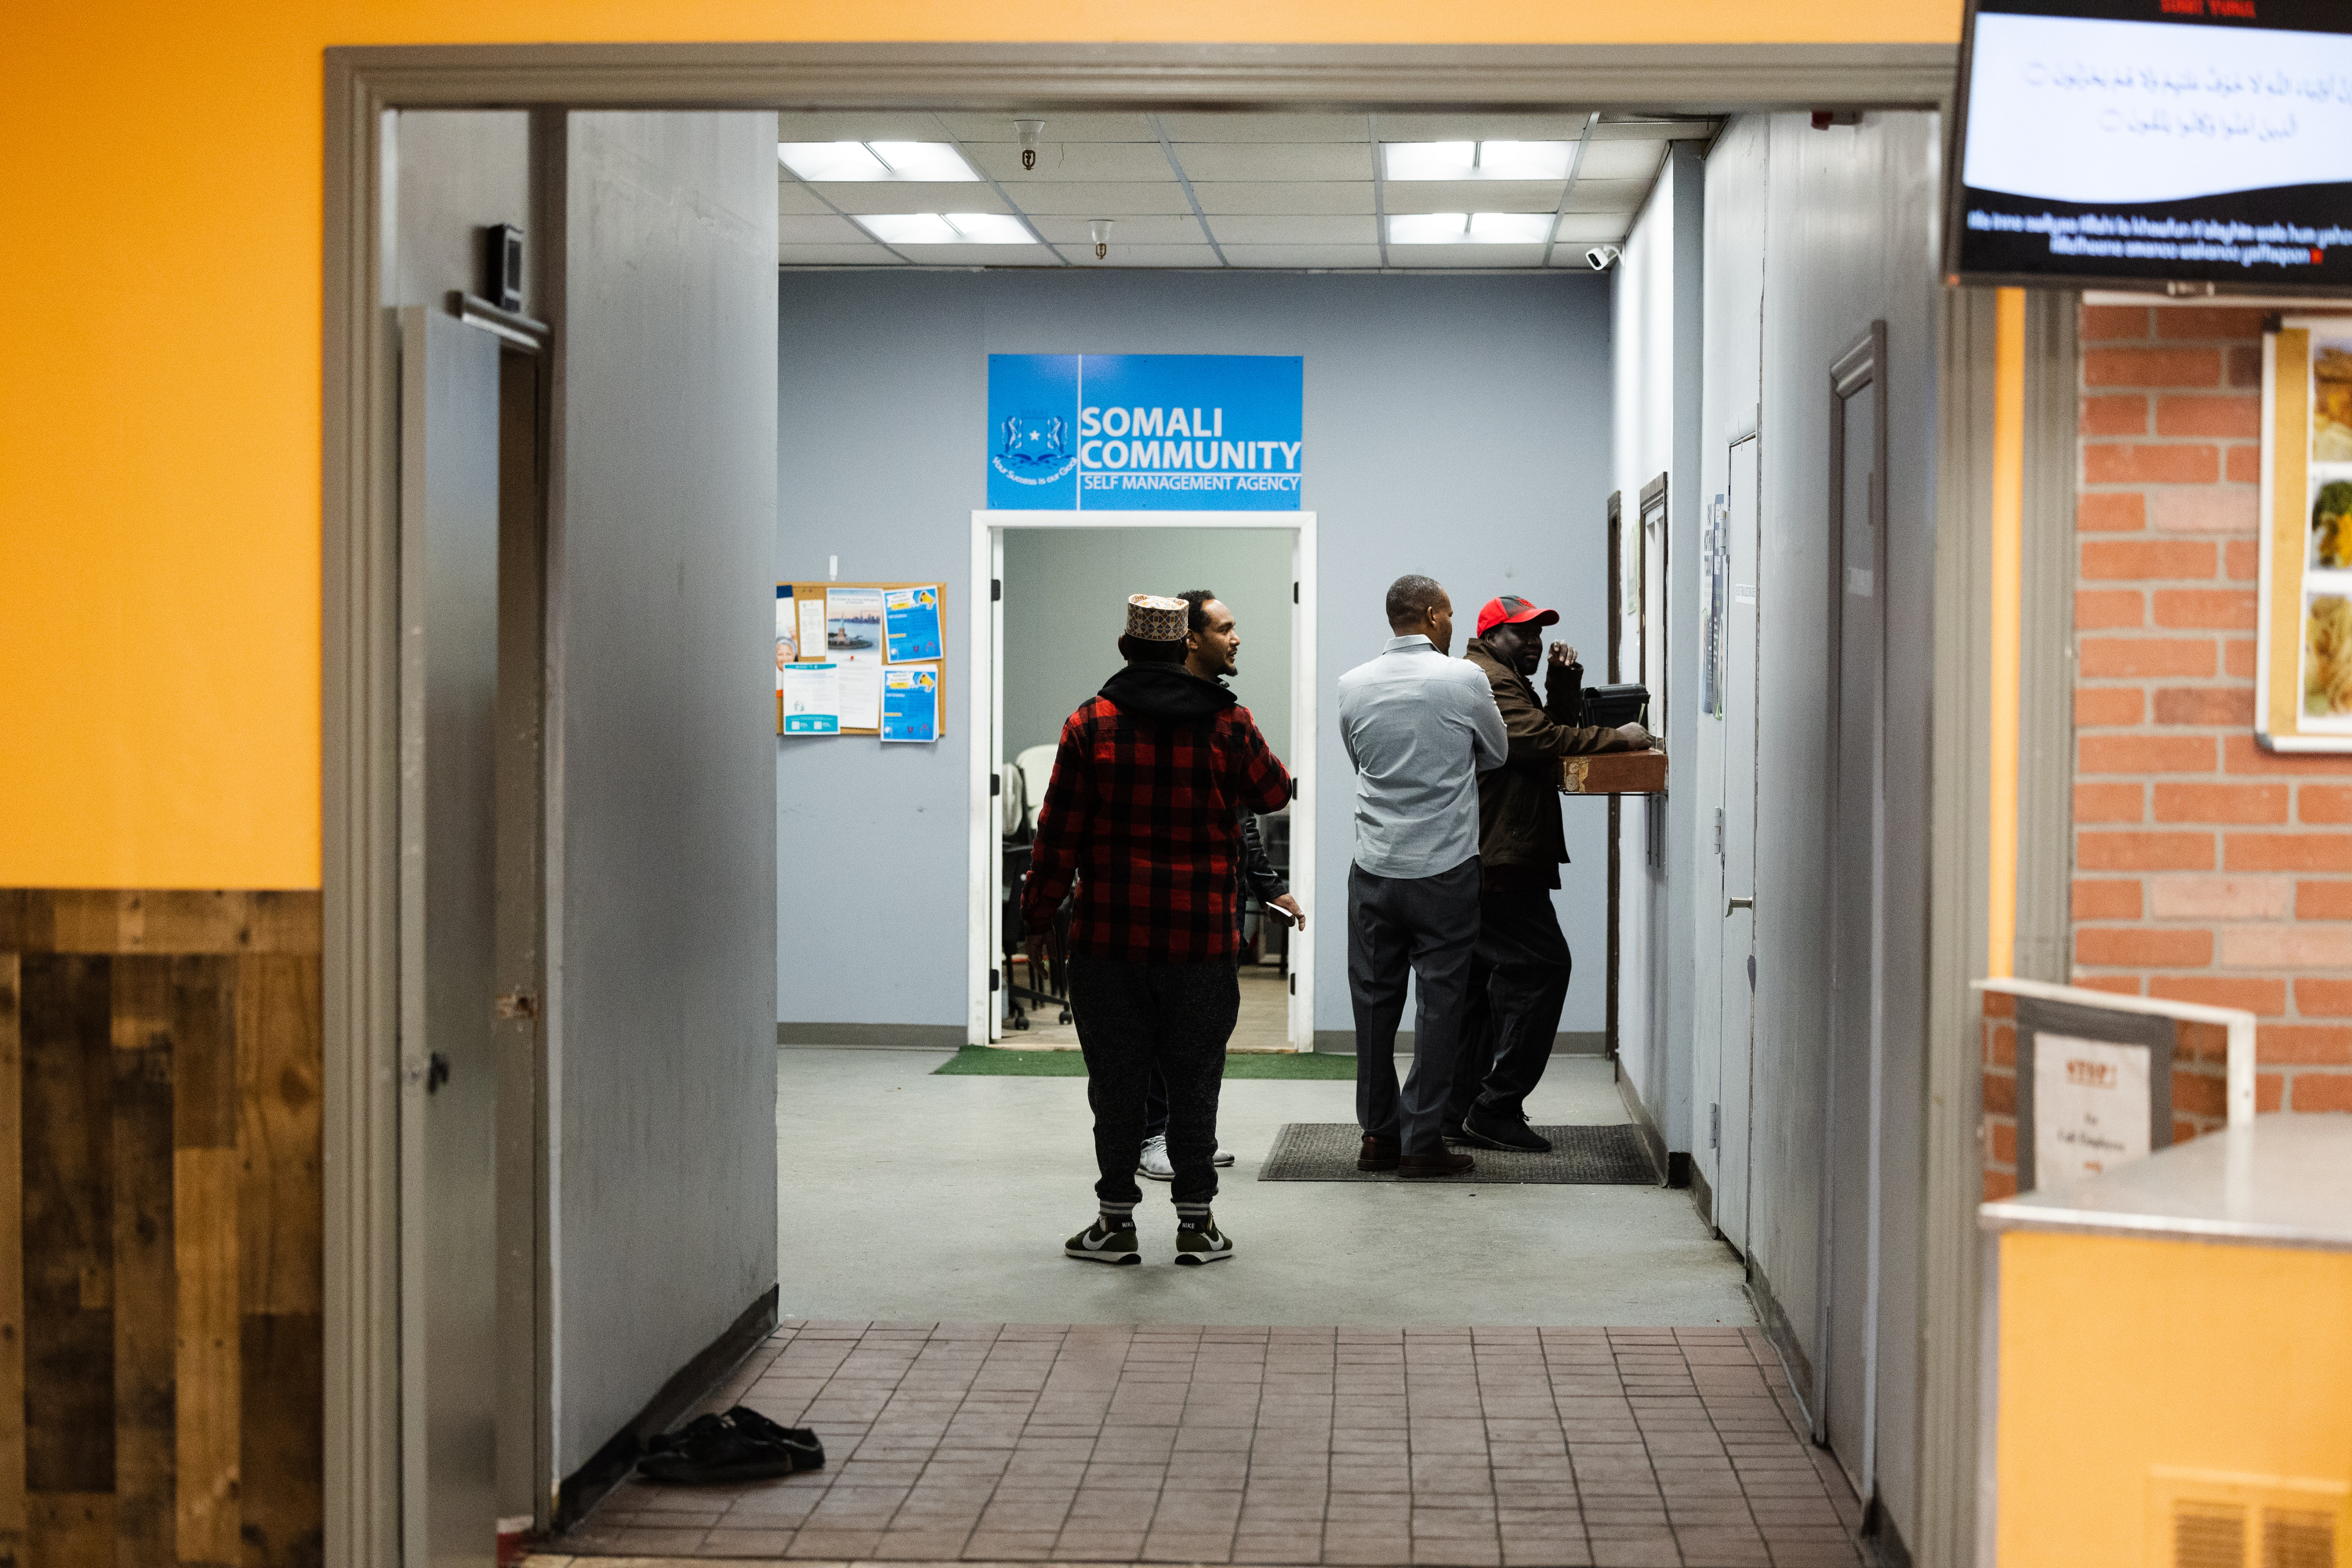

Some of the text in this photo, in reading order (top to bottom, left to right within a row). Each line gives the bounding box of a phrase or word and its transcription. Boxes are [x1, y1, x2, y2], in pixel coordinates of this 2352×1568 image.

[1081, 407, 1222, 437] SOMALI
[1081, 440, 1301, 469] COMMUNITY
[992, 456, 1008, 474] Your
[1006, 470, 1037, 485] Success
[1047, 473, 1060, 483] our
[1084, 476, 1299, 491] SELF MANAGEMENT AGENCY
